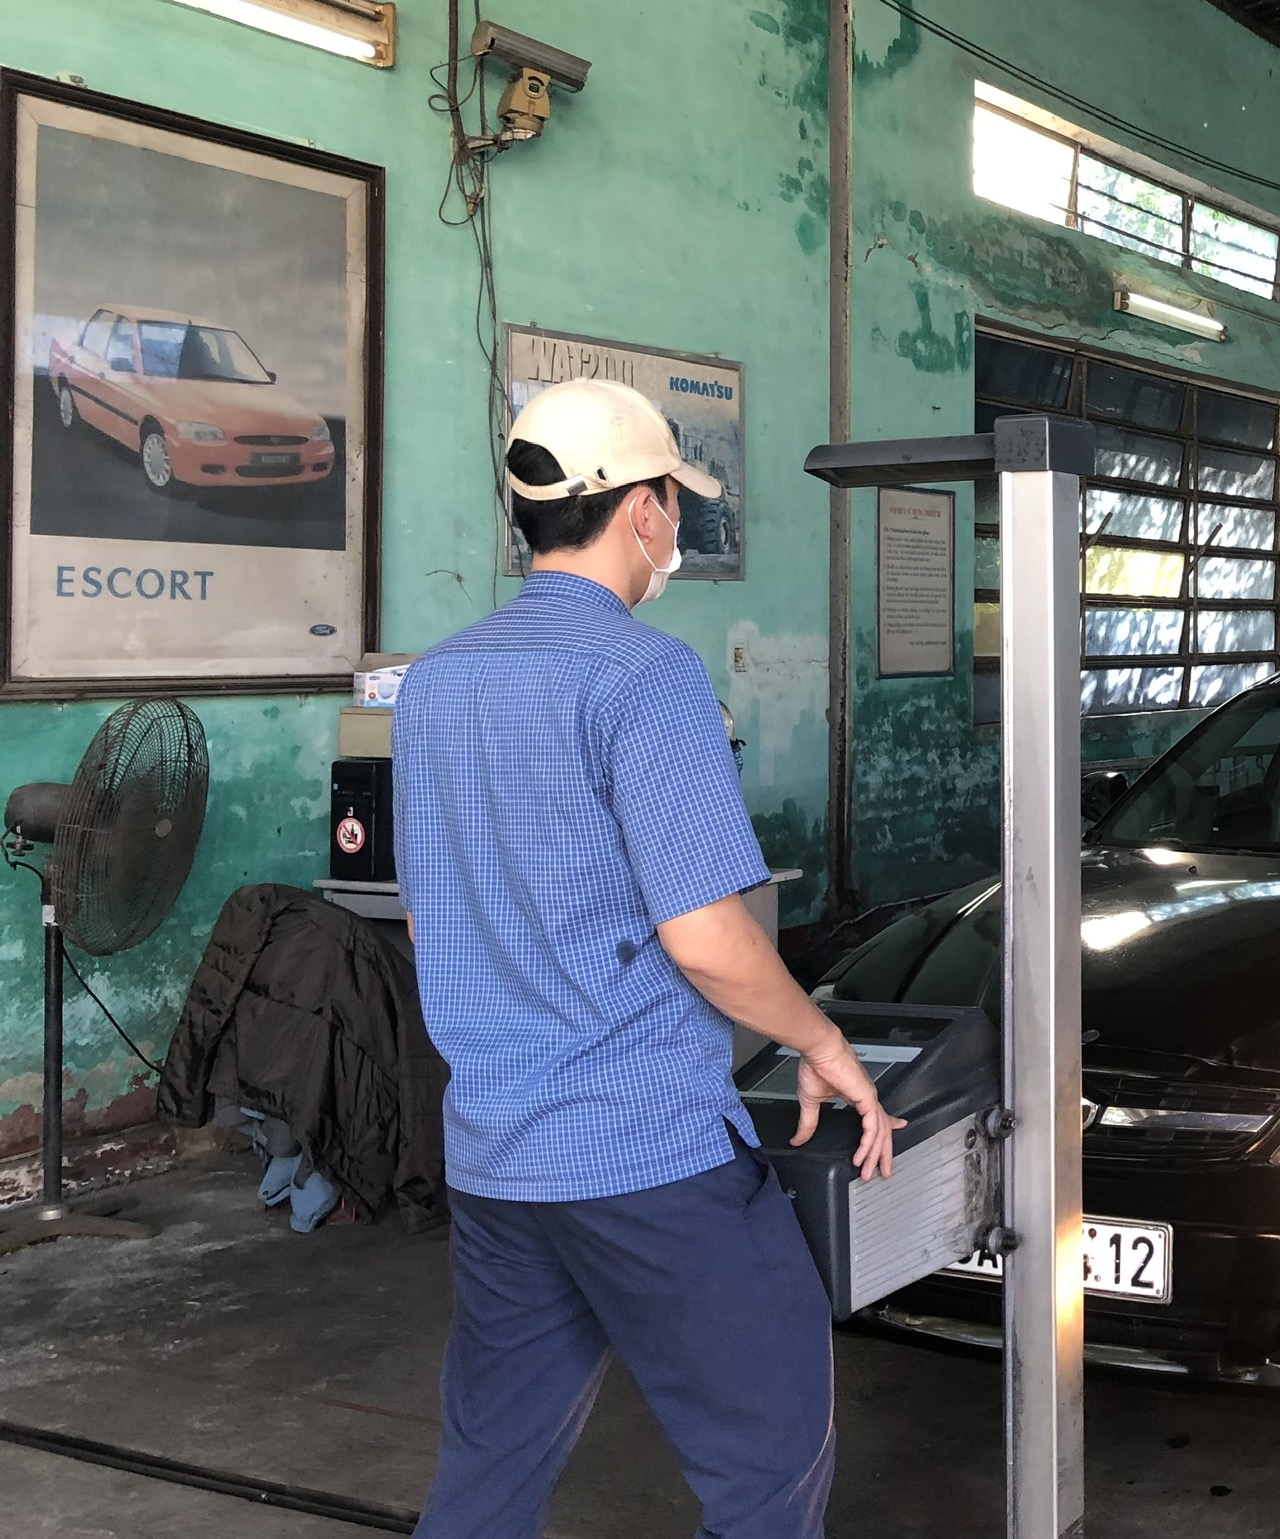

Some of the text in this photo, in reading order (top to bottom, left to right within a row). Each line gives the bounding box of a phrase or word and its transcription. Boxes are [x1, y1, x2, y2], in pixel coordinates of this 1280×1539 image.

[669, 376, 733, 400] KOMATSU
[56, 565, 214, 601] ESCORT
[1085, 1233, 1155, 1288] 12
